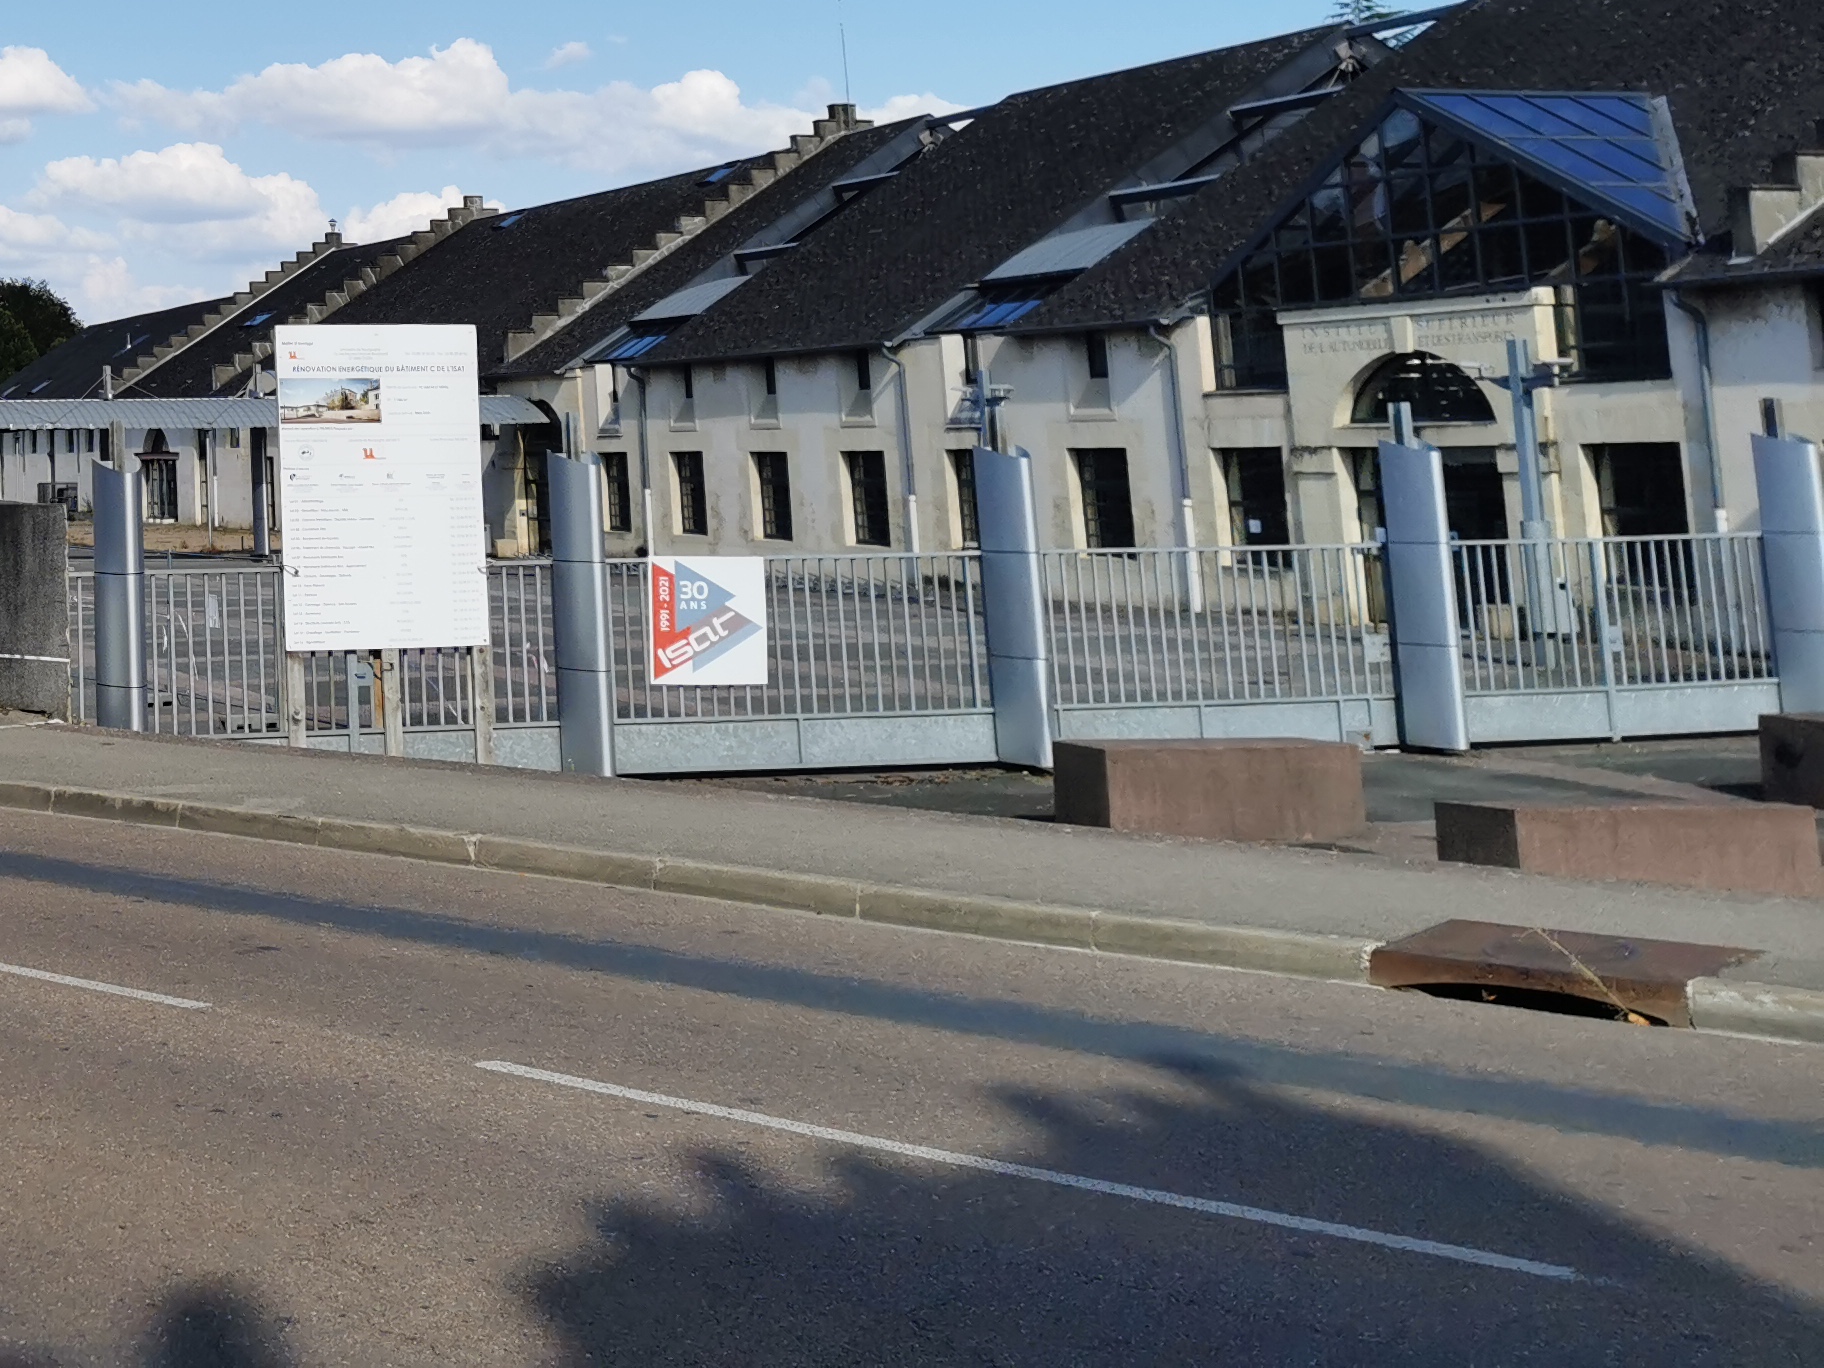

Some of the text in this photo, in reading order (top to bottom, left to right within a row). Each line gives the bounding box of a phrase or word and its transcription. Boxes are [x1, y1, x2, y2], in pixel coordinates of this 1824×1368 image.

[659, 576, 670, 602] 2021
[679, 581, 709, 599] 30
[679, 600, 707, 610] ANS
[660, 609, 671, 632] 1991
